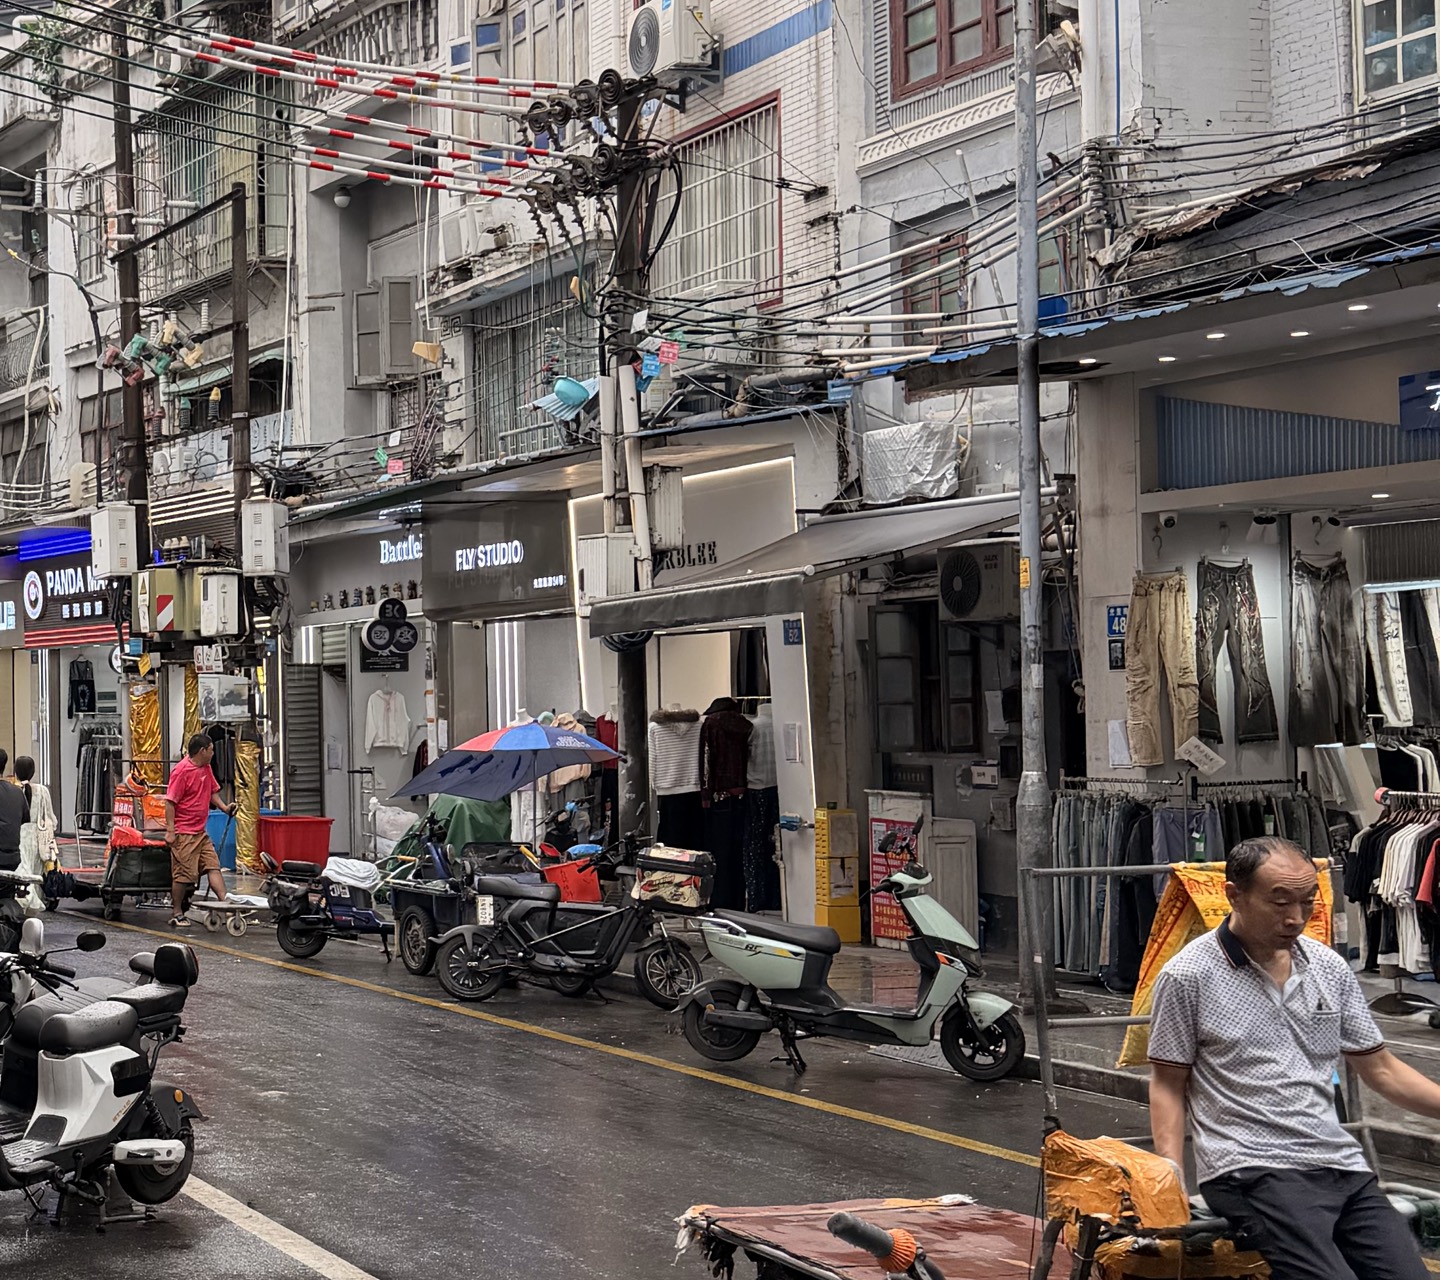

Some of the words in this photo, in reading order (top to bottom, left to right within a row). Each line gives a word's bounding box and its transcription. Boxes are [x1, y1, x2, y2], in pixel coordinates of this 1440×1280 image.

[379, 533, 423, 564] Battle
[45, 566, 85, 597] PANDA
[788, 629, 800, 642] 52
[1112, 616, 1127, 633] 48
